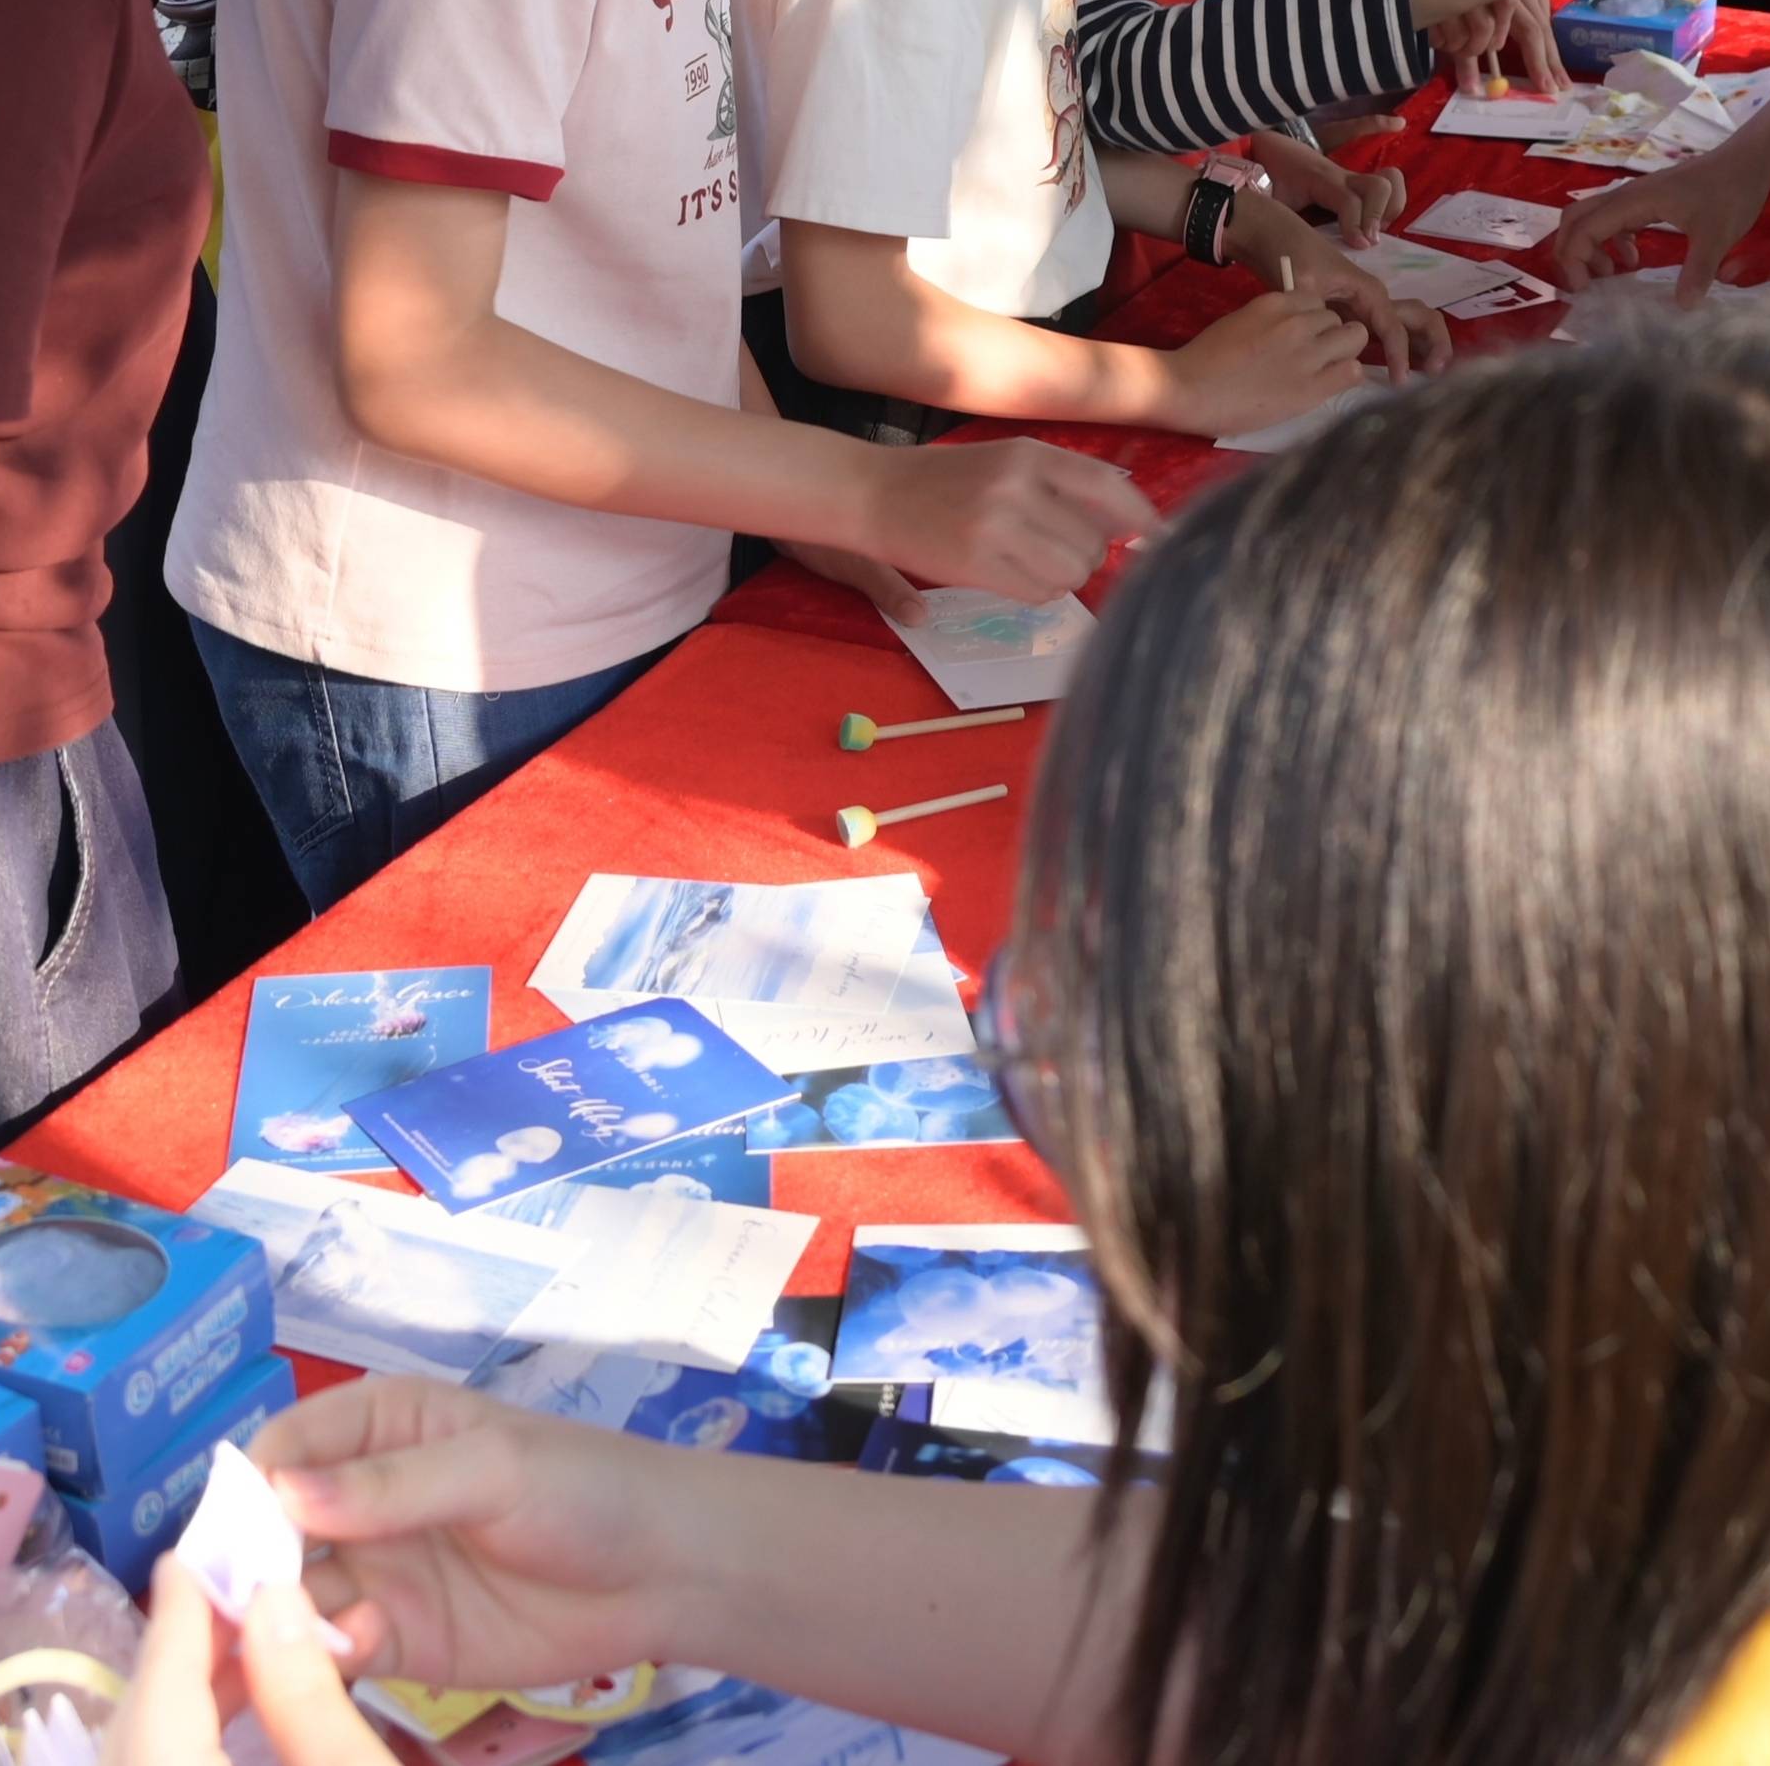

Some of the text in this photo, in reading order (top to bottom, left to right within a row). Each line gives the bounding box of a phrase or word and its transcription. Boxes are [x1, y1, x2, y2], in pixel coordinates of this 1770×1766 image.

[685, 62, 709, 96] 1990
[677, 178, 723, 227] IT'S
[395, 979, 475, 1008] Grace
